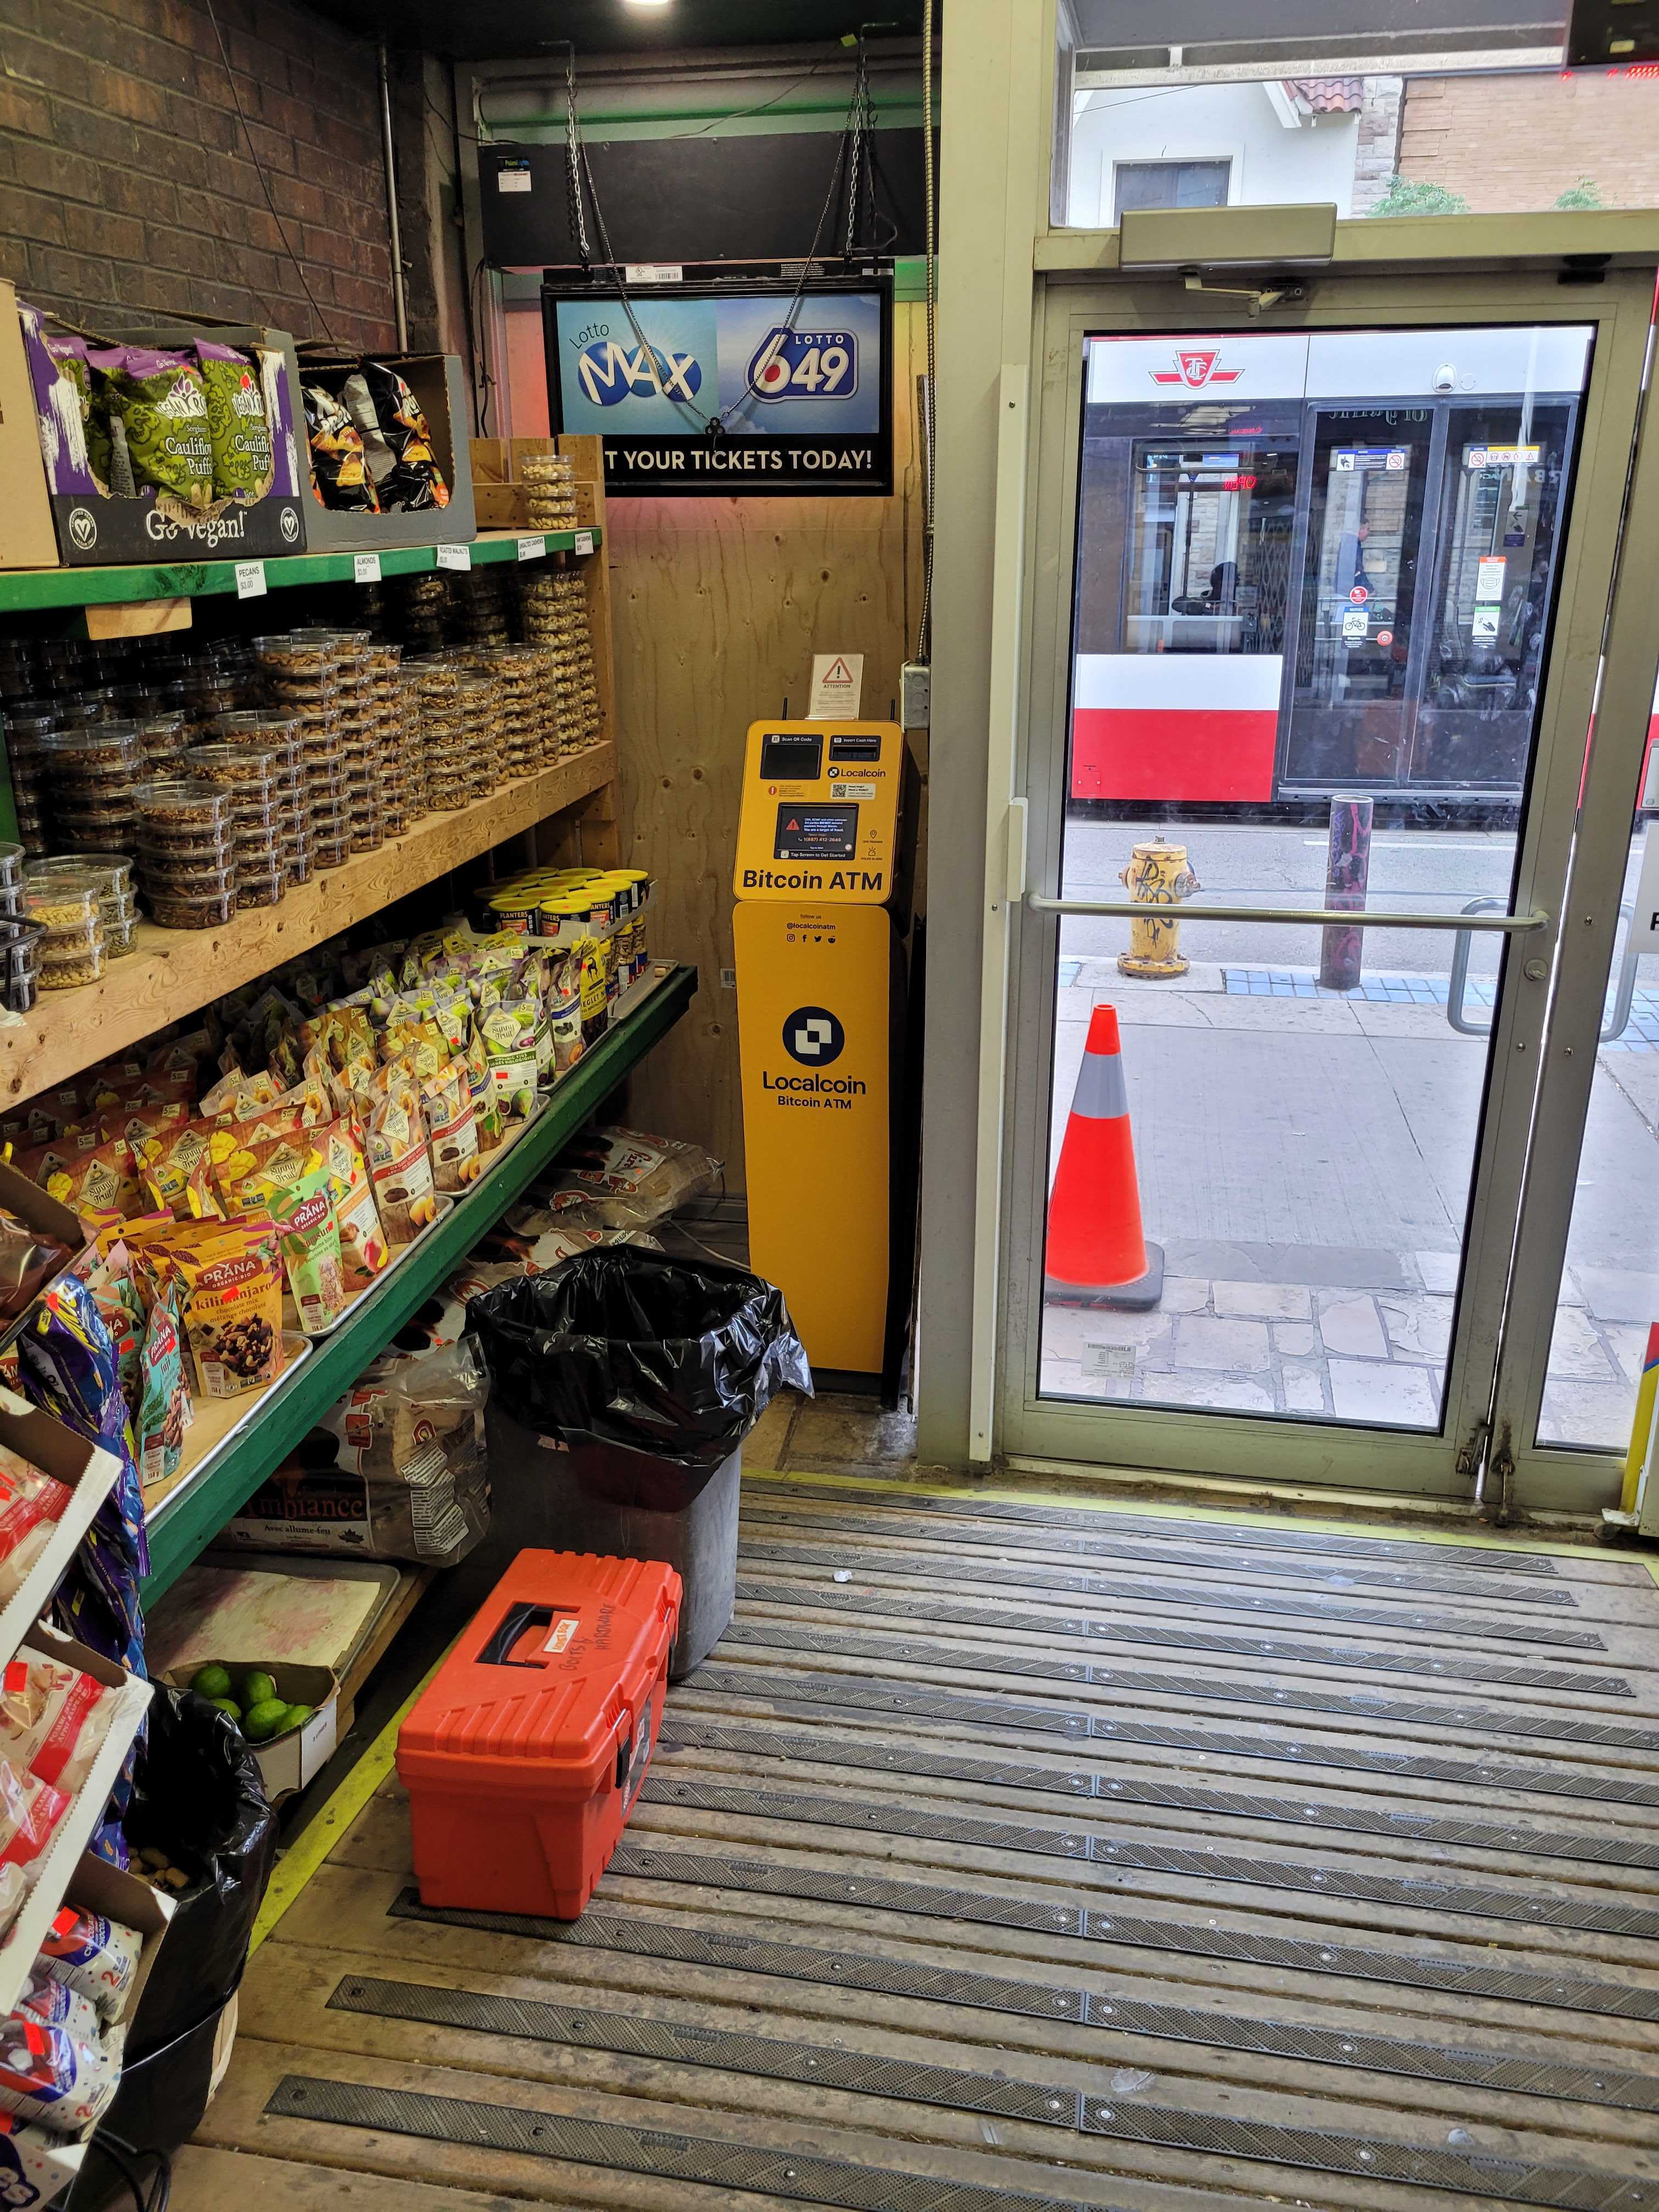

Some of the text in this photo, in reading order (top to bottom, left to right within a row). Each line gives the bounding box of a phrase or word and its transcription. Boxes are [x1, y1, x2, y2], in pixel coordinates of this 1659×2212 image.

[569, 323, 610, 349] Lotto
[795, 334, 844, 345] LOTTO
[579, 342, 695, 405] MAX
[624, 451, 684, 470] YOUR
[691, 450, 782, 470] TICKETS
[788, 450, 872, 469] TODAY!
[357, 557, 376, 565] ALMONDS
[239, 566, 259, 578] PECANS
[240, 579, 254, 590] $3.00
[841, 768, 886, 777] Localcoin
[743, 870, 882, 890] Bitcoin ATM
[492, 1024, 515, 1036] Sunny
[763, 1071, 866, 1094] Localcoin
[778, 1096, 851, 1109] Bitcoin ATM
[387, 1117, 404, 1132] Sunny
[177, 1147, 202, 1162] Sunny
[270, 1162, 296, 1176] Sunny
[275, 1172, 296, 1183] Fruit
[89, 1180, 114, 1197] Sunny
[94, 1190, 114, 1205] Fruit
[210, 1301, 267, 1323] mélange chocolaté
[216, 1298, 258, 1315] chocolate mix
[265, 1524, 331, 1535] Avec allume-feu
[594, 1602, 616, 1650] HARDWARE
[558, 1645, 585, 1671] BOLTS
[101, 1970, 120, 1987] 2
